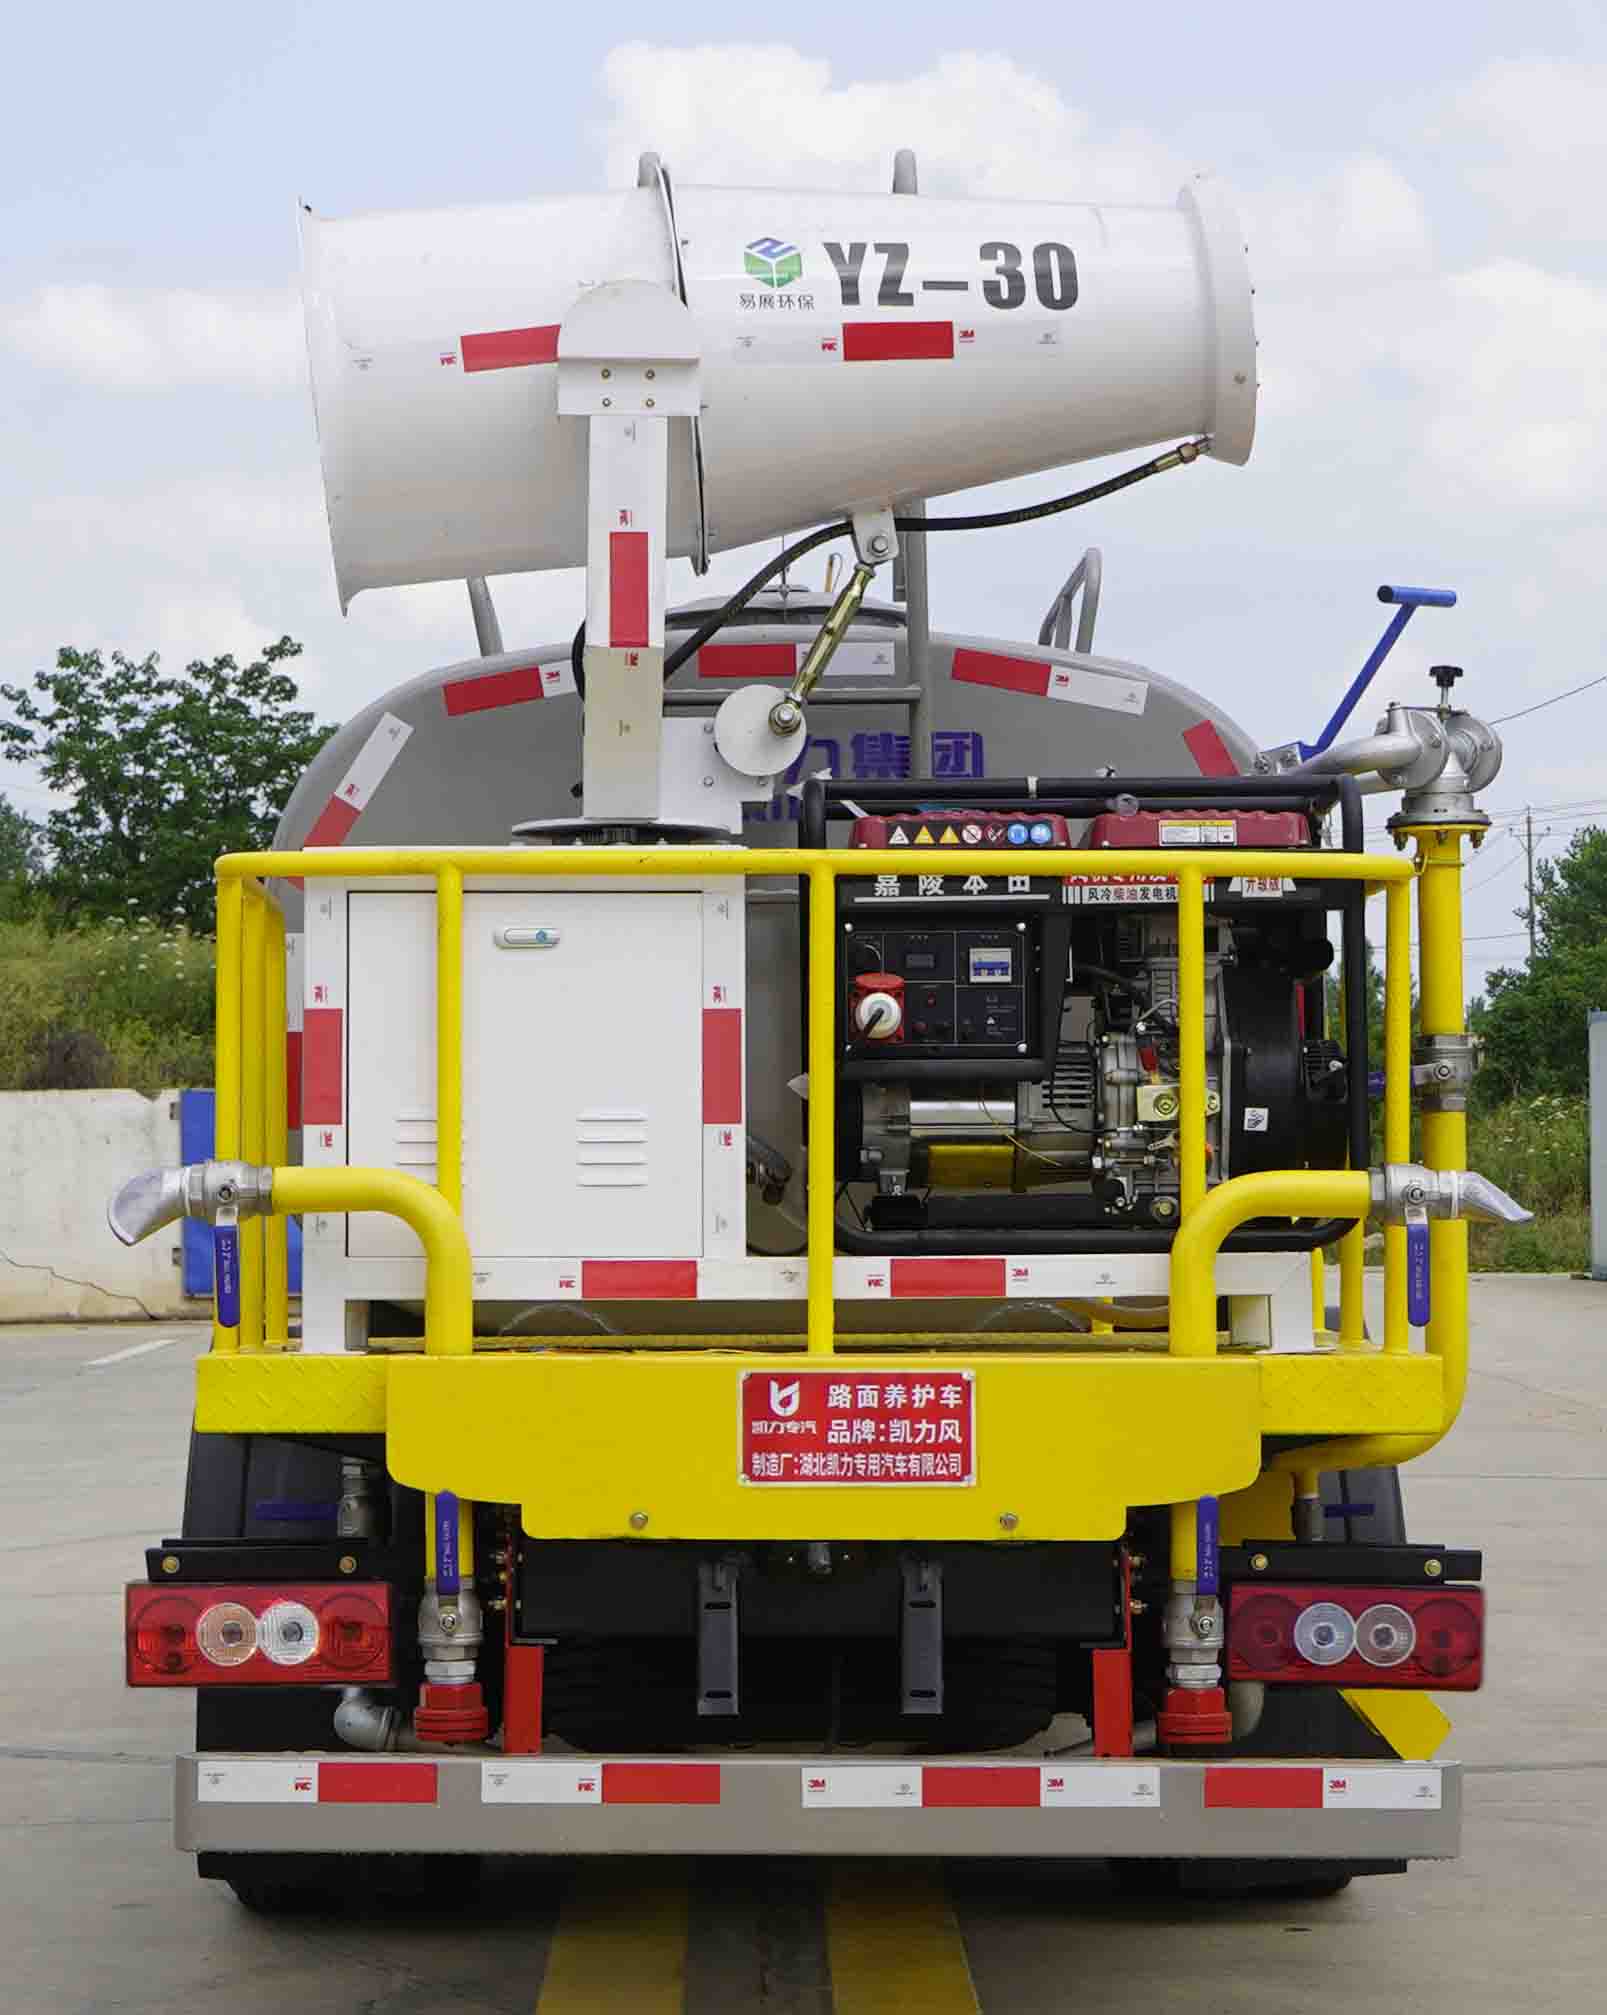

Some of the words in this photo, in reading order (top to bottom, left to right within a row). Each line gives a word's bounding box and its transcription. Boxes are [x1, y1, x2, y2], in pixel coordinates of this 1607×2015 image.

[739, 294, 815, 311] 易展环保
[826, 1384, 964, 1409] 路面养护车
[751, 1420, 817, 1434] 凯力专汽
[827, 1419, 963, 1445] 品牌:凯力风
